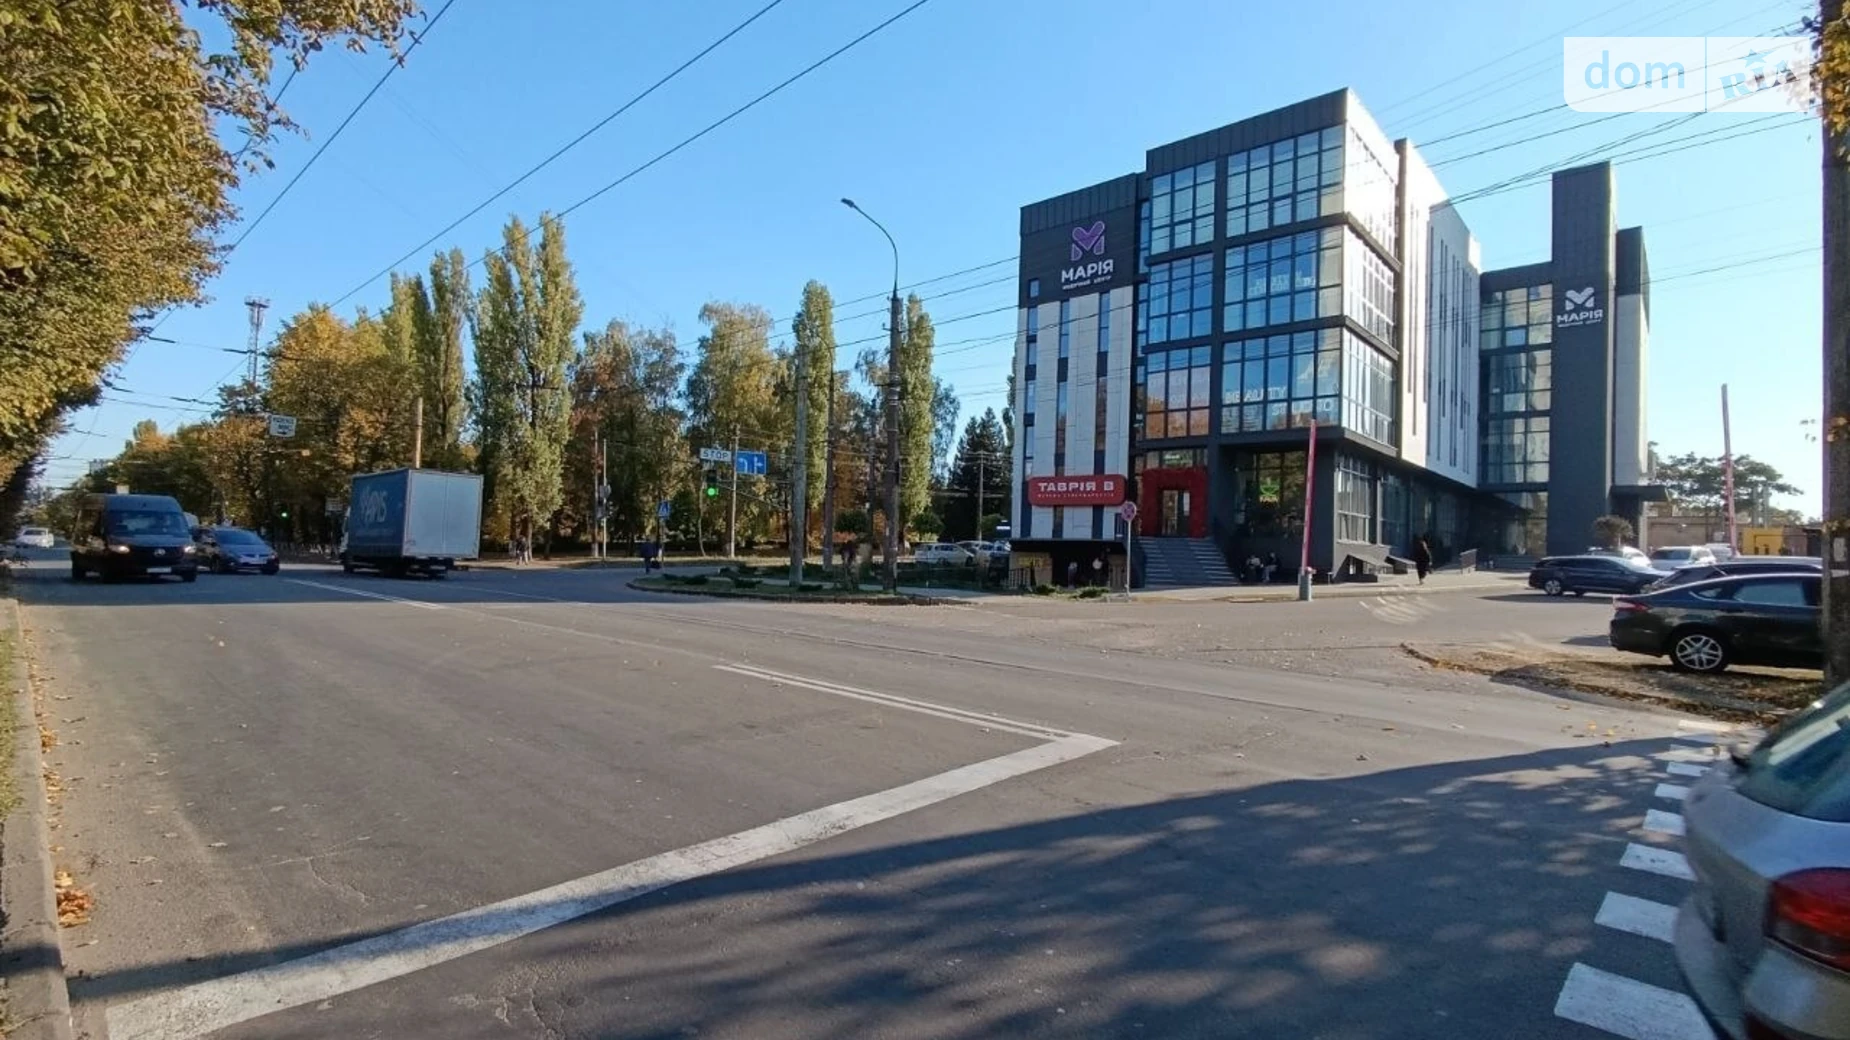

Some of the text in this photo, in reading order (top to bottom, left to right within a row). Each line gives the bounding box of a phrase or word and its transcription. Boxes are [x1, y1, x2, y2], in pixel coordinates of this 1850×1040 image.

[1061, 259, 1114, 283] МАРІЯ
[1556, 309, 1603, 323] МАРІЯ
[1225, 386, 1287, 403] BEAUTY
[703, 449, 729, 459] STOP
[1037, 480, 1115, 492] ТАВРІЯ В
